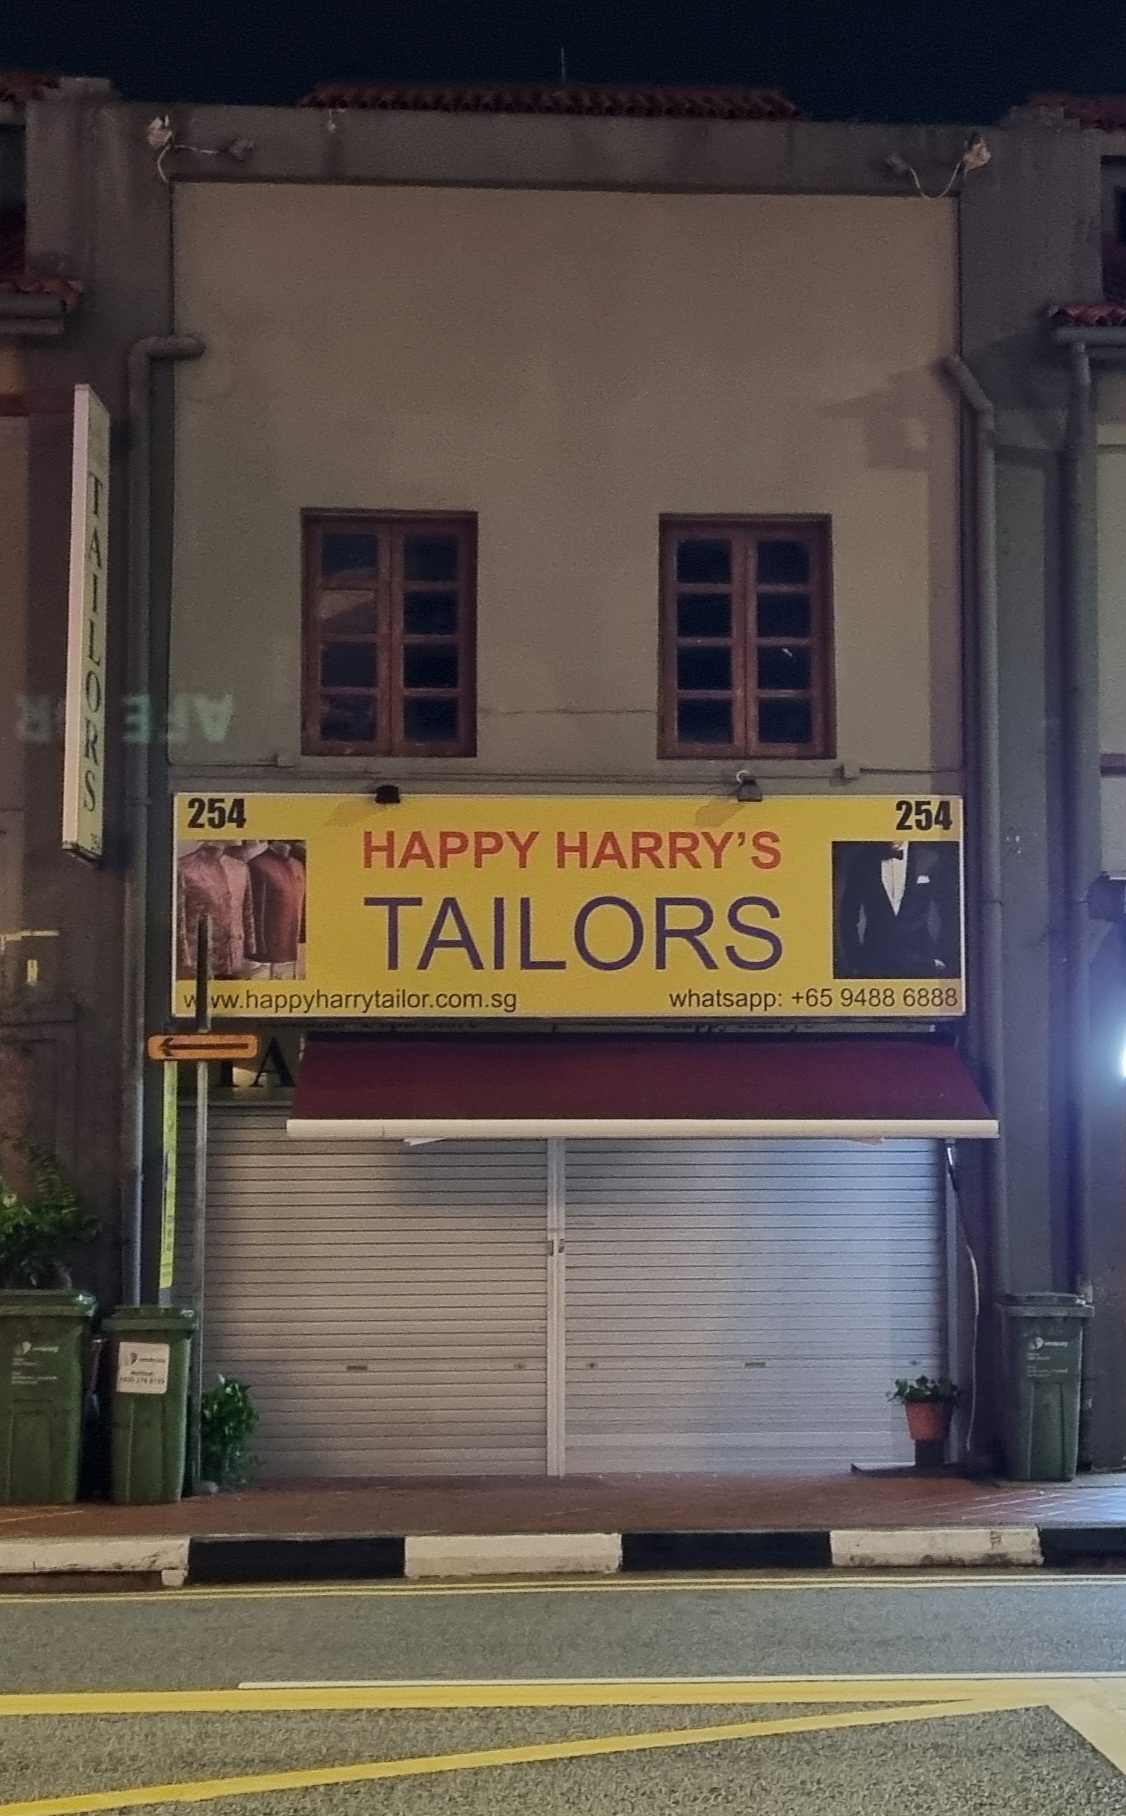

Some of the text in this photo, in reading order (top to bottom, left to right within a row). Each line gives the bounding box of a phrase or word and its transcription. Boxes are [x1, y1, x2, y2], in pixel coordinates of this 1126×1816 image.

[83, 470, 103, 812] TAILORS
[187, 797, 247, 829] 254
[895, 800, 953, 831] 254
[362, 830, 783, 870] HAPPY HARRY’S
[363, 895, 783, 972] TAILORS
[184, 989, 517, 1013] www.happyharrytailor.com.sg
[669, 987, 958, 1012] whatsapp: +65 9488 6888
